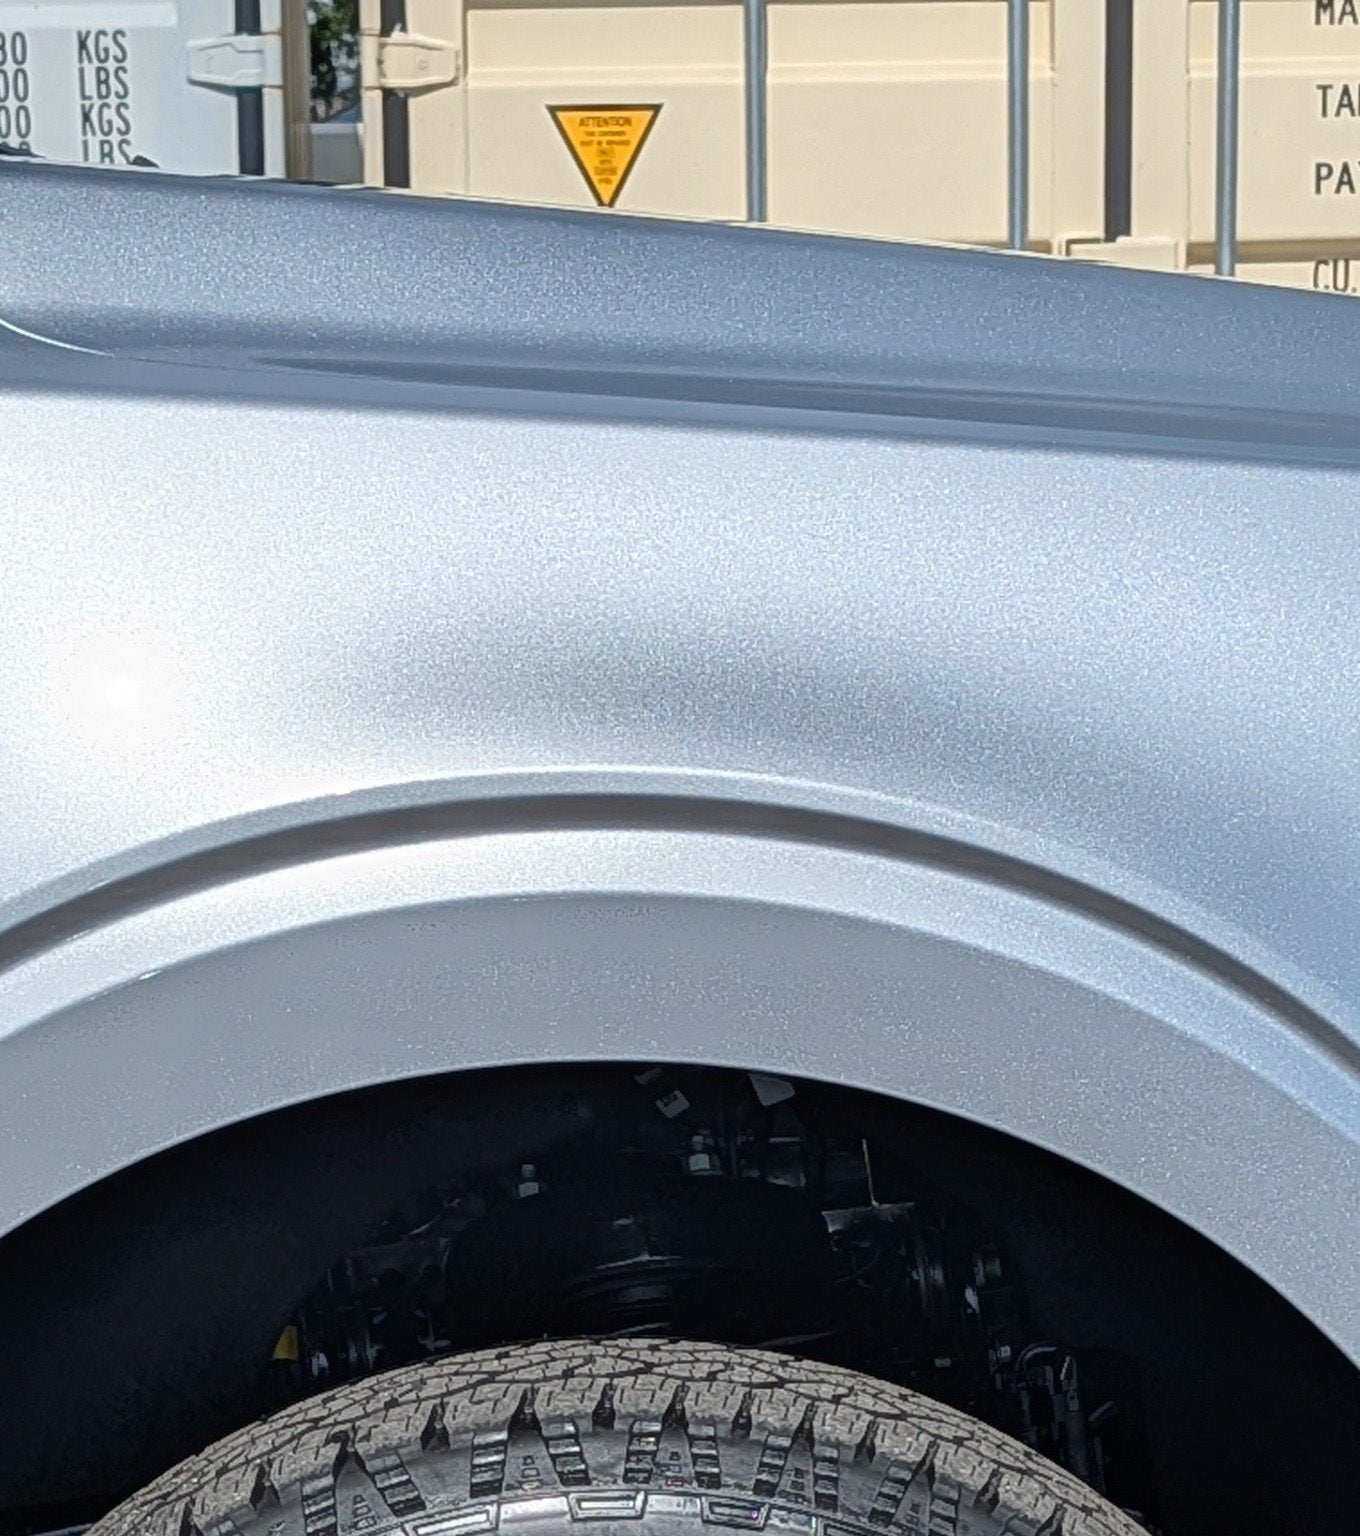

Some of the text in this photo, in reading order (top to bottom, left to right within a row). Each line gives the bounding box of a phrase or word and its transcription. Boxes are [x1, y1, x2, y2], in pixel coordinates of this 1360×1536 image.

[77, 29, 128, 64] KGS
[78, 65, 130, 101] LBS
[80, 101, 132, 137] KGS
[1313, 258, 1357, 293] CU.
